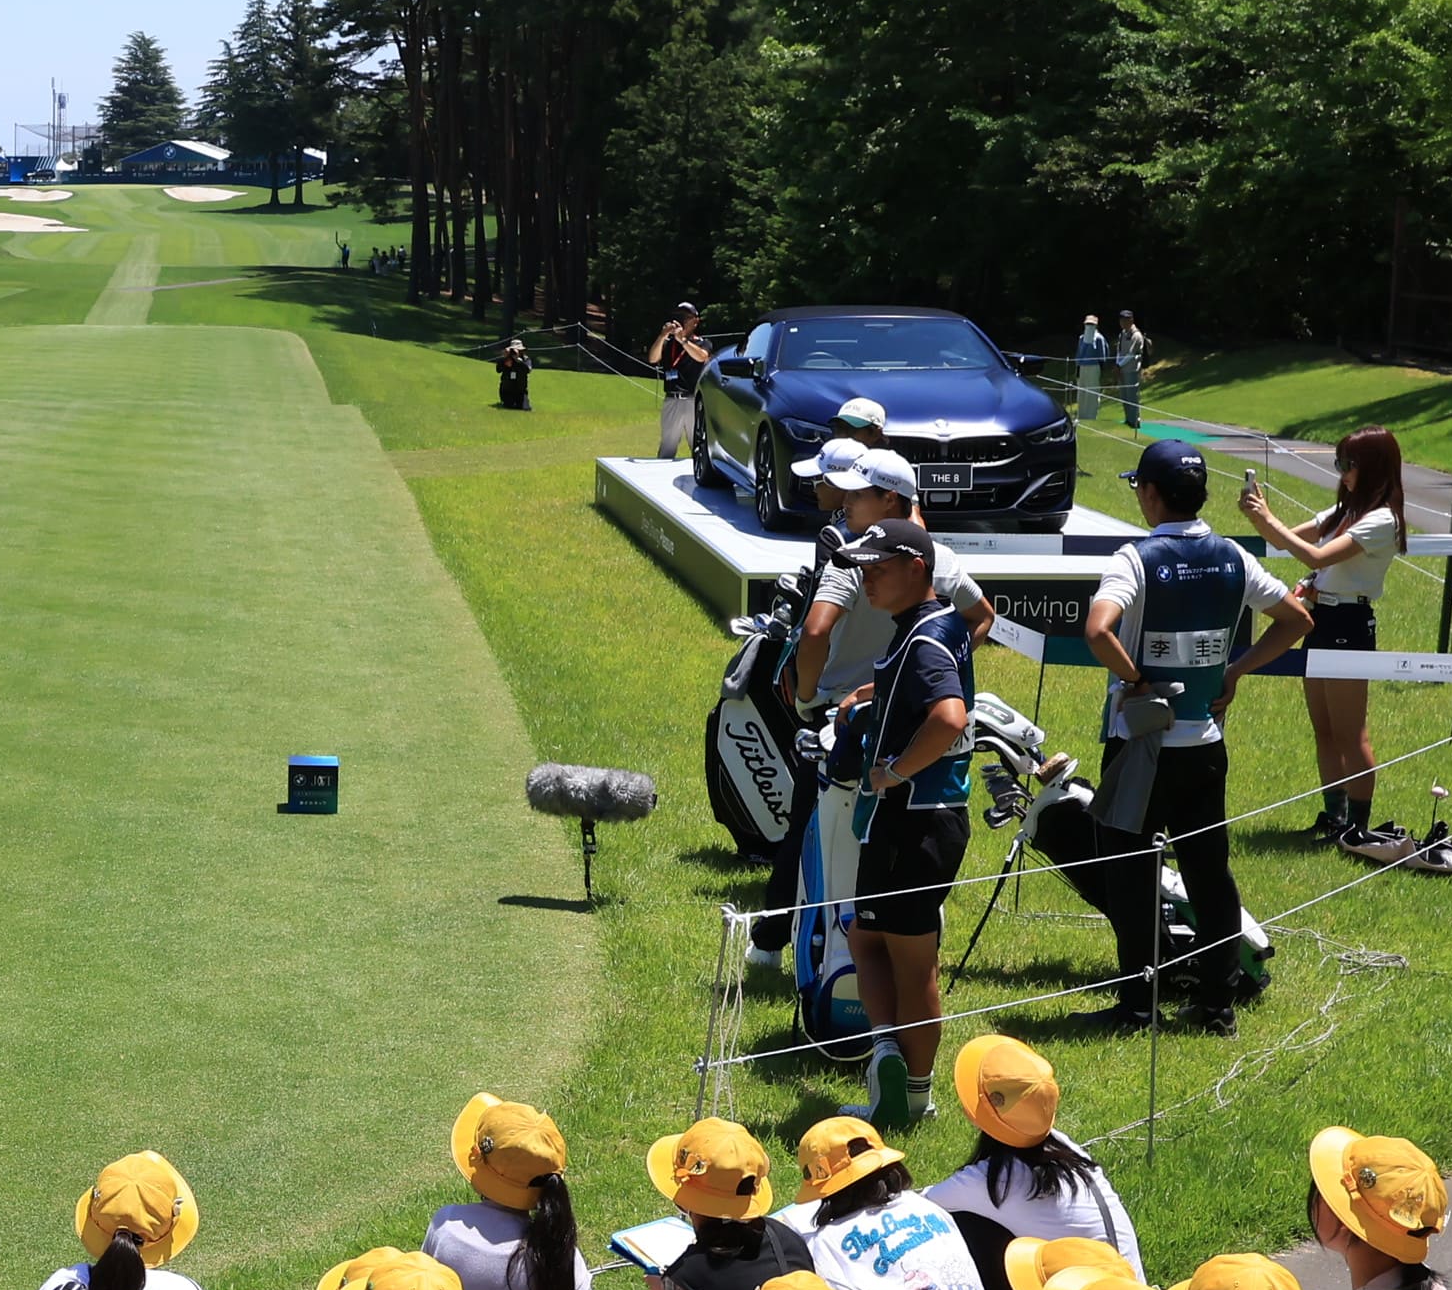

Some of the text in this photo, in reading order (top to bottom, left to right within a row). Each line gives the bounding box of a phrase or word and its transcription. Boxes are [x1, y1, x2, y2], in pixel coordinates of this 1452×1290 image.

[931, 474, 960, 483] THE 8
[994, 594, 1079, 623] Driving
[1150, 639, 1171, 658] 李
[725, 721, 792, 826] Titleist
